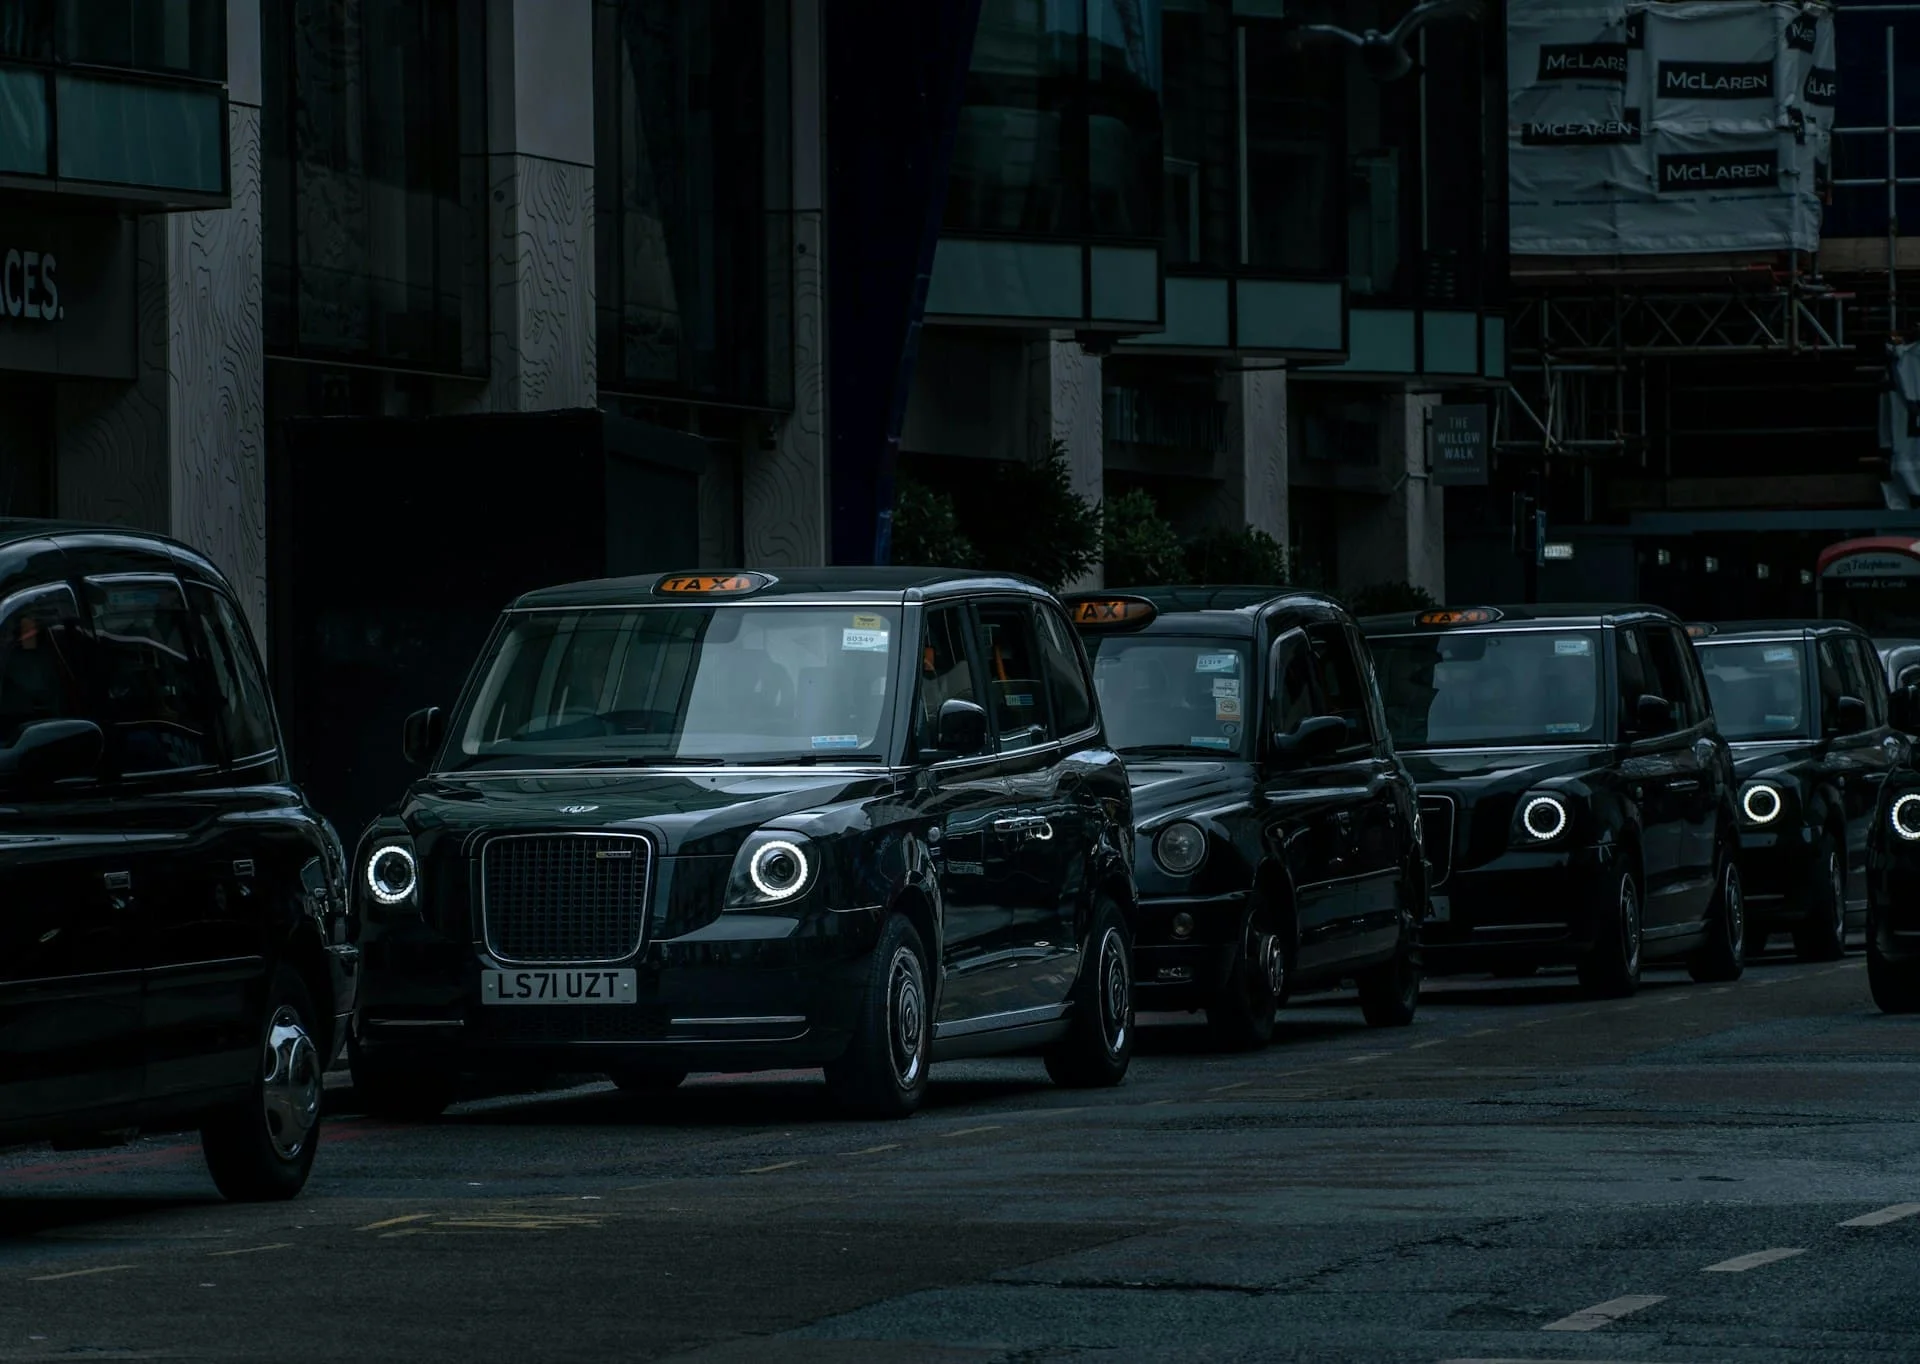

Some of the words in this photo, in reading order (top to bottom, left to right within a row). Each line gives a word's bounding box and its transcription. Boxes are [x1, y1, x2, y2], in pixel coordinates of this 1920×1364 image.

[1665, 69, 1769, 91] McLAREN
[1665, 162, 1771, 182] McLAREN
[1448, 416, 1469, 429] THE
[1437, 431, 1481, 444] WILLOW
[1444, 446, 1475, 460] WALK
[671, 578, 743, 590] TAXI
[498, 973, 557, 999] LS71
[566, 973, 619, 998] UZT
